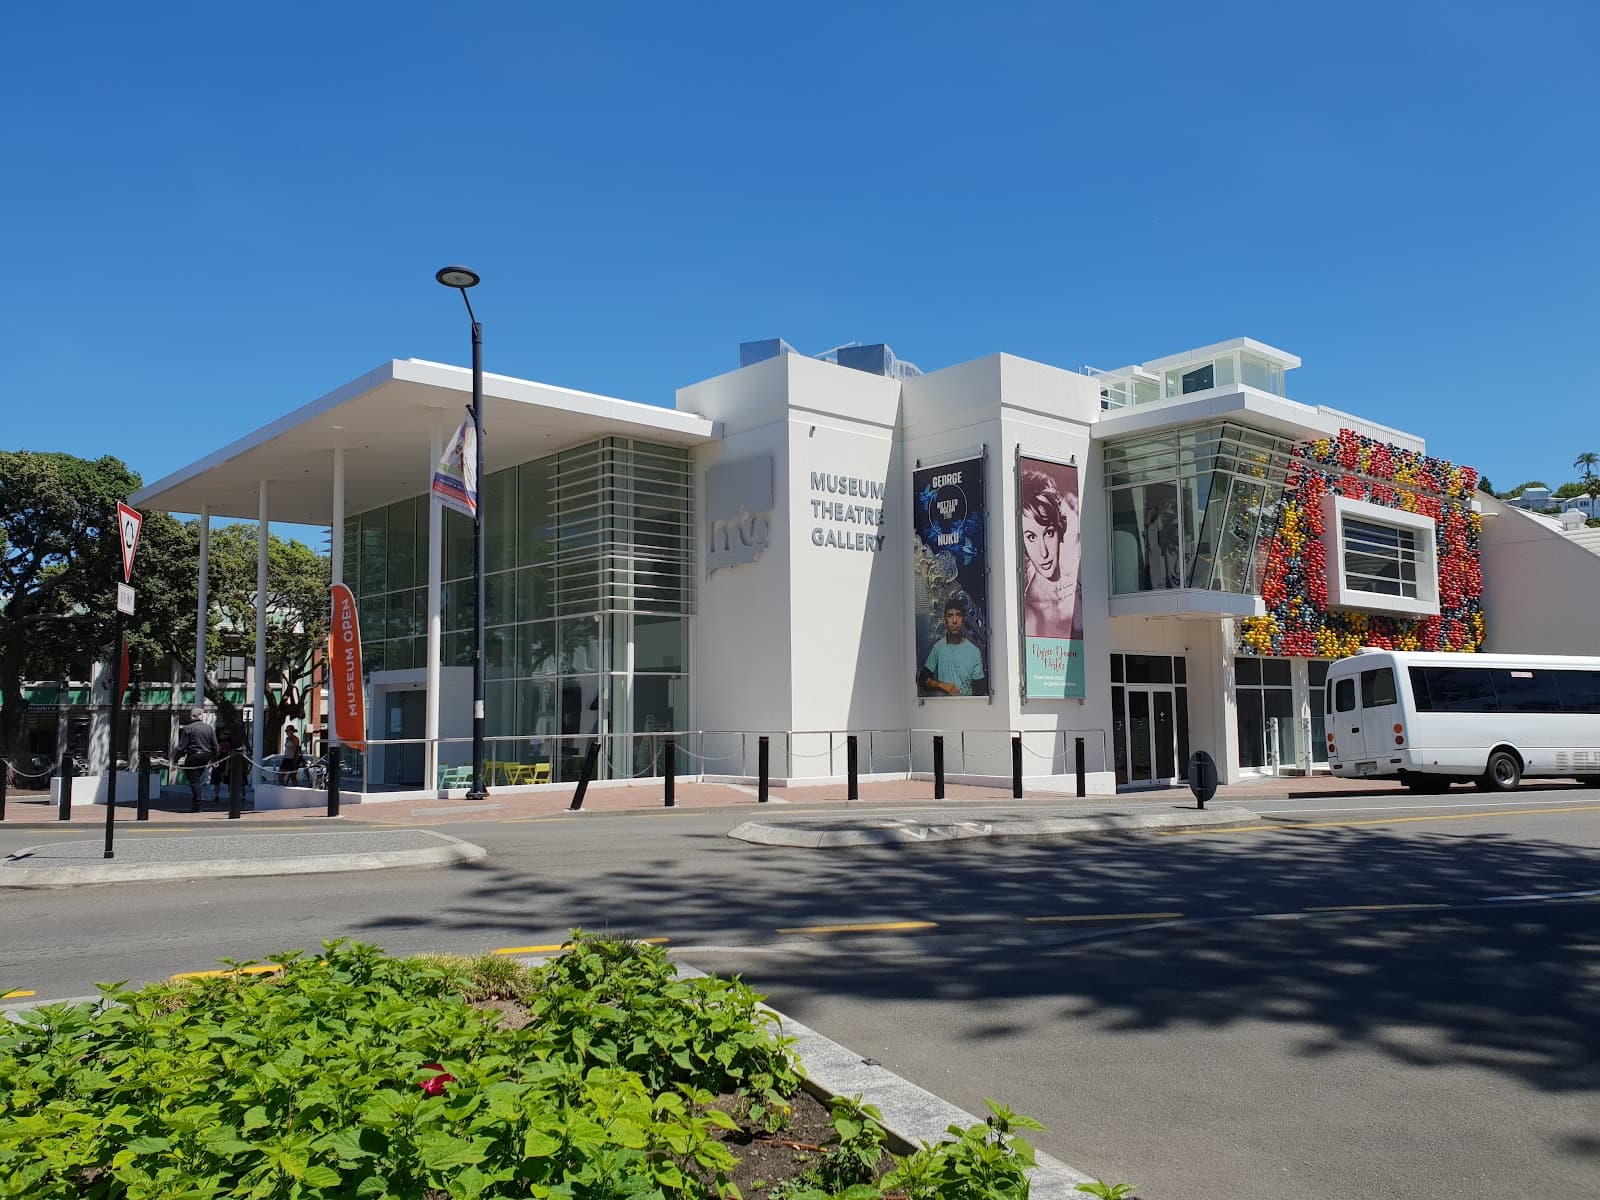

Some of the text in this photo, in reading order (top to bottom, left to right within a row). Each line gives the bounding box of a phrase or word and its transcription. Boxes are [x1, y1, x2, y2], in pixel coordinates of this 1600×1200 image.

[811, 472, 884, 500] MUSEUM
[932, 471, 962, 488] GEORGE
[811, 499, 884, 526] THEATRE
[811, 527, 885, 552] GALLERY
[937, 532, 959, 546] NUKU
[342, 598, 358, 717] MUSEUM OPEN
